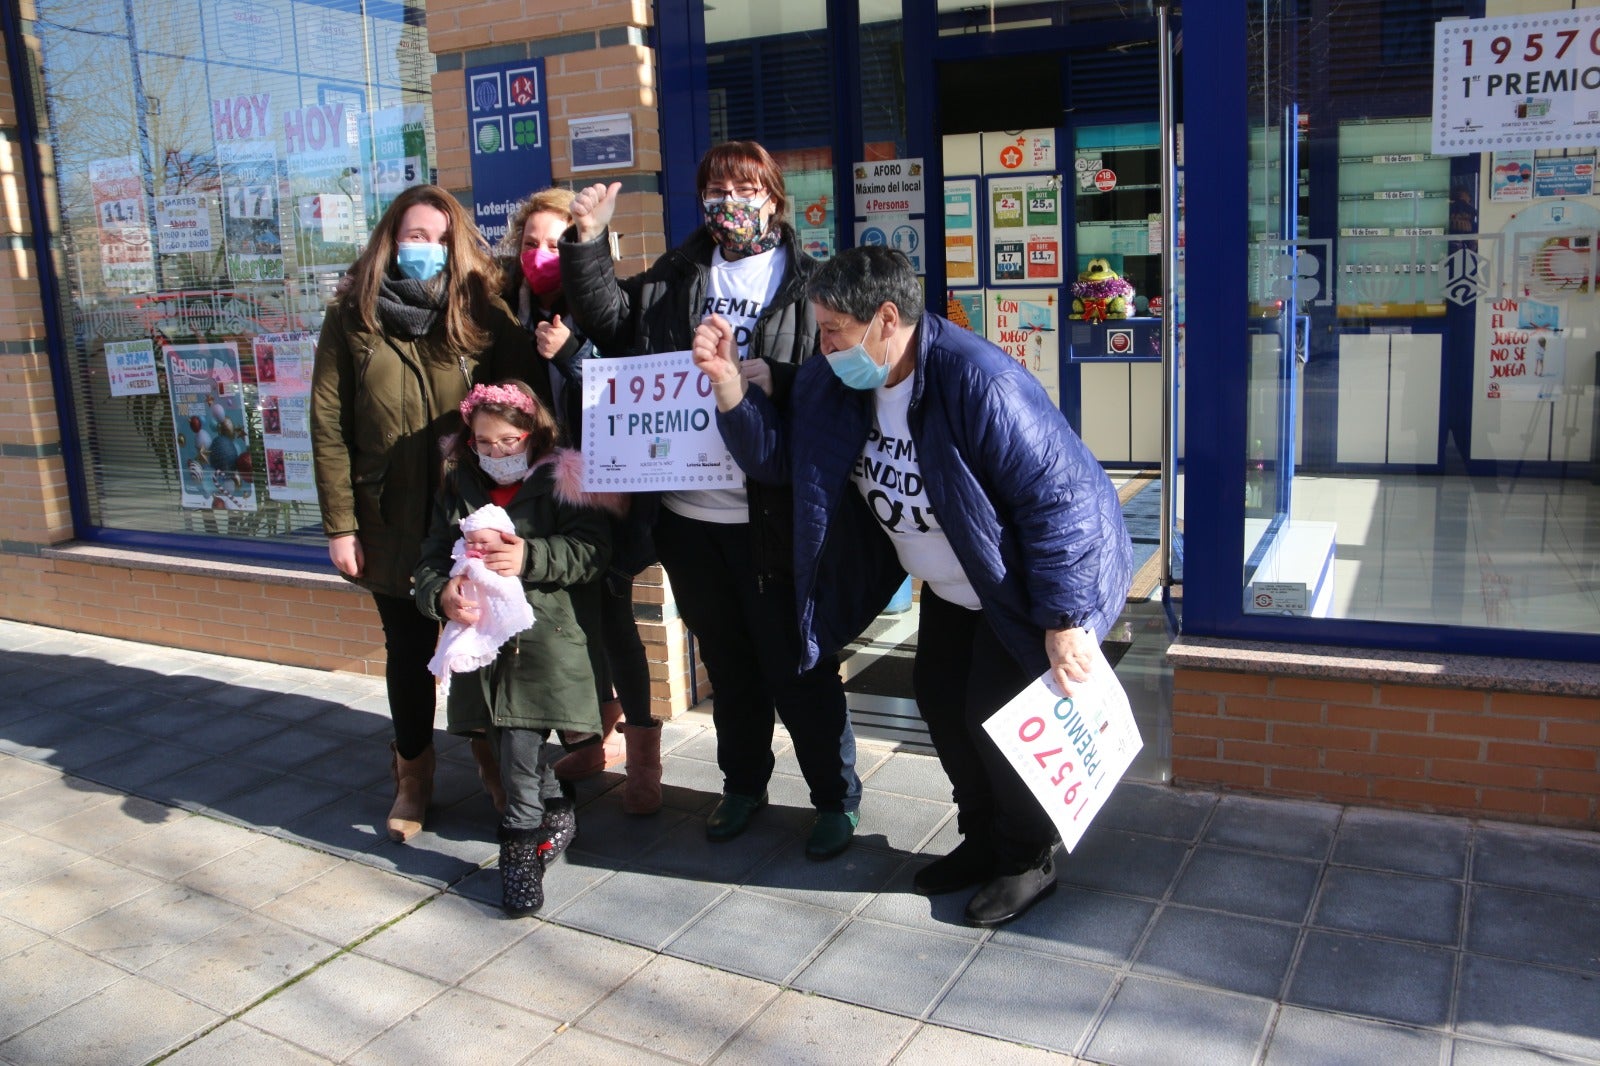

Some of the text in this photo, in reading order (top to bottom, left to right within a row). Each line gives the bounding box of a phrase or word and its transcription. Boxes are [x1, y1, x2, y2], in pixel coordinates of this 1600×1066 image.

[1487, 66, 1600, 97] PREMIO
[214, 93, 270, 140] HOY
[284, 103, 344, 153] HOY
[874, 164, 902, 177] AFORO
[856, 180, 921, 195] Máximo del local
[233, 187, 266, 216] 17
[866, 199, 909, 211] 4 Personas
[479, 223, 506, 241] Apue
[228, 253, 285, 280] Martes
[1001, 254, 1013, 262] 17
[702, 296, 760, 319] REMI
[998, 330, 1028, 343] JUEGO
[1491, 331, 1529, 346] JUEGO
[1016, 344, 1026, 357] SE
[1490, 346, 1526, 362] NO SE
[178, 358, 208, 374] ENERO
[1489, 363, 1526, 378] JUEGA
[607, 371, 713, 405] 19570
[629, 408, 709, 436] PREMIO
[852, 456, 923, 497] ENDID
[1054, 696, 1101, 777] PREMIO
[1018, 716, 1089, 822] 19570
